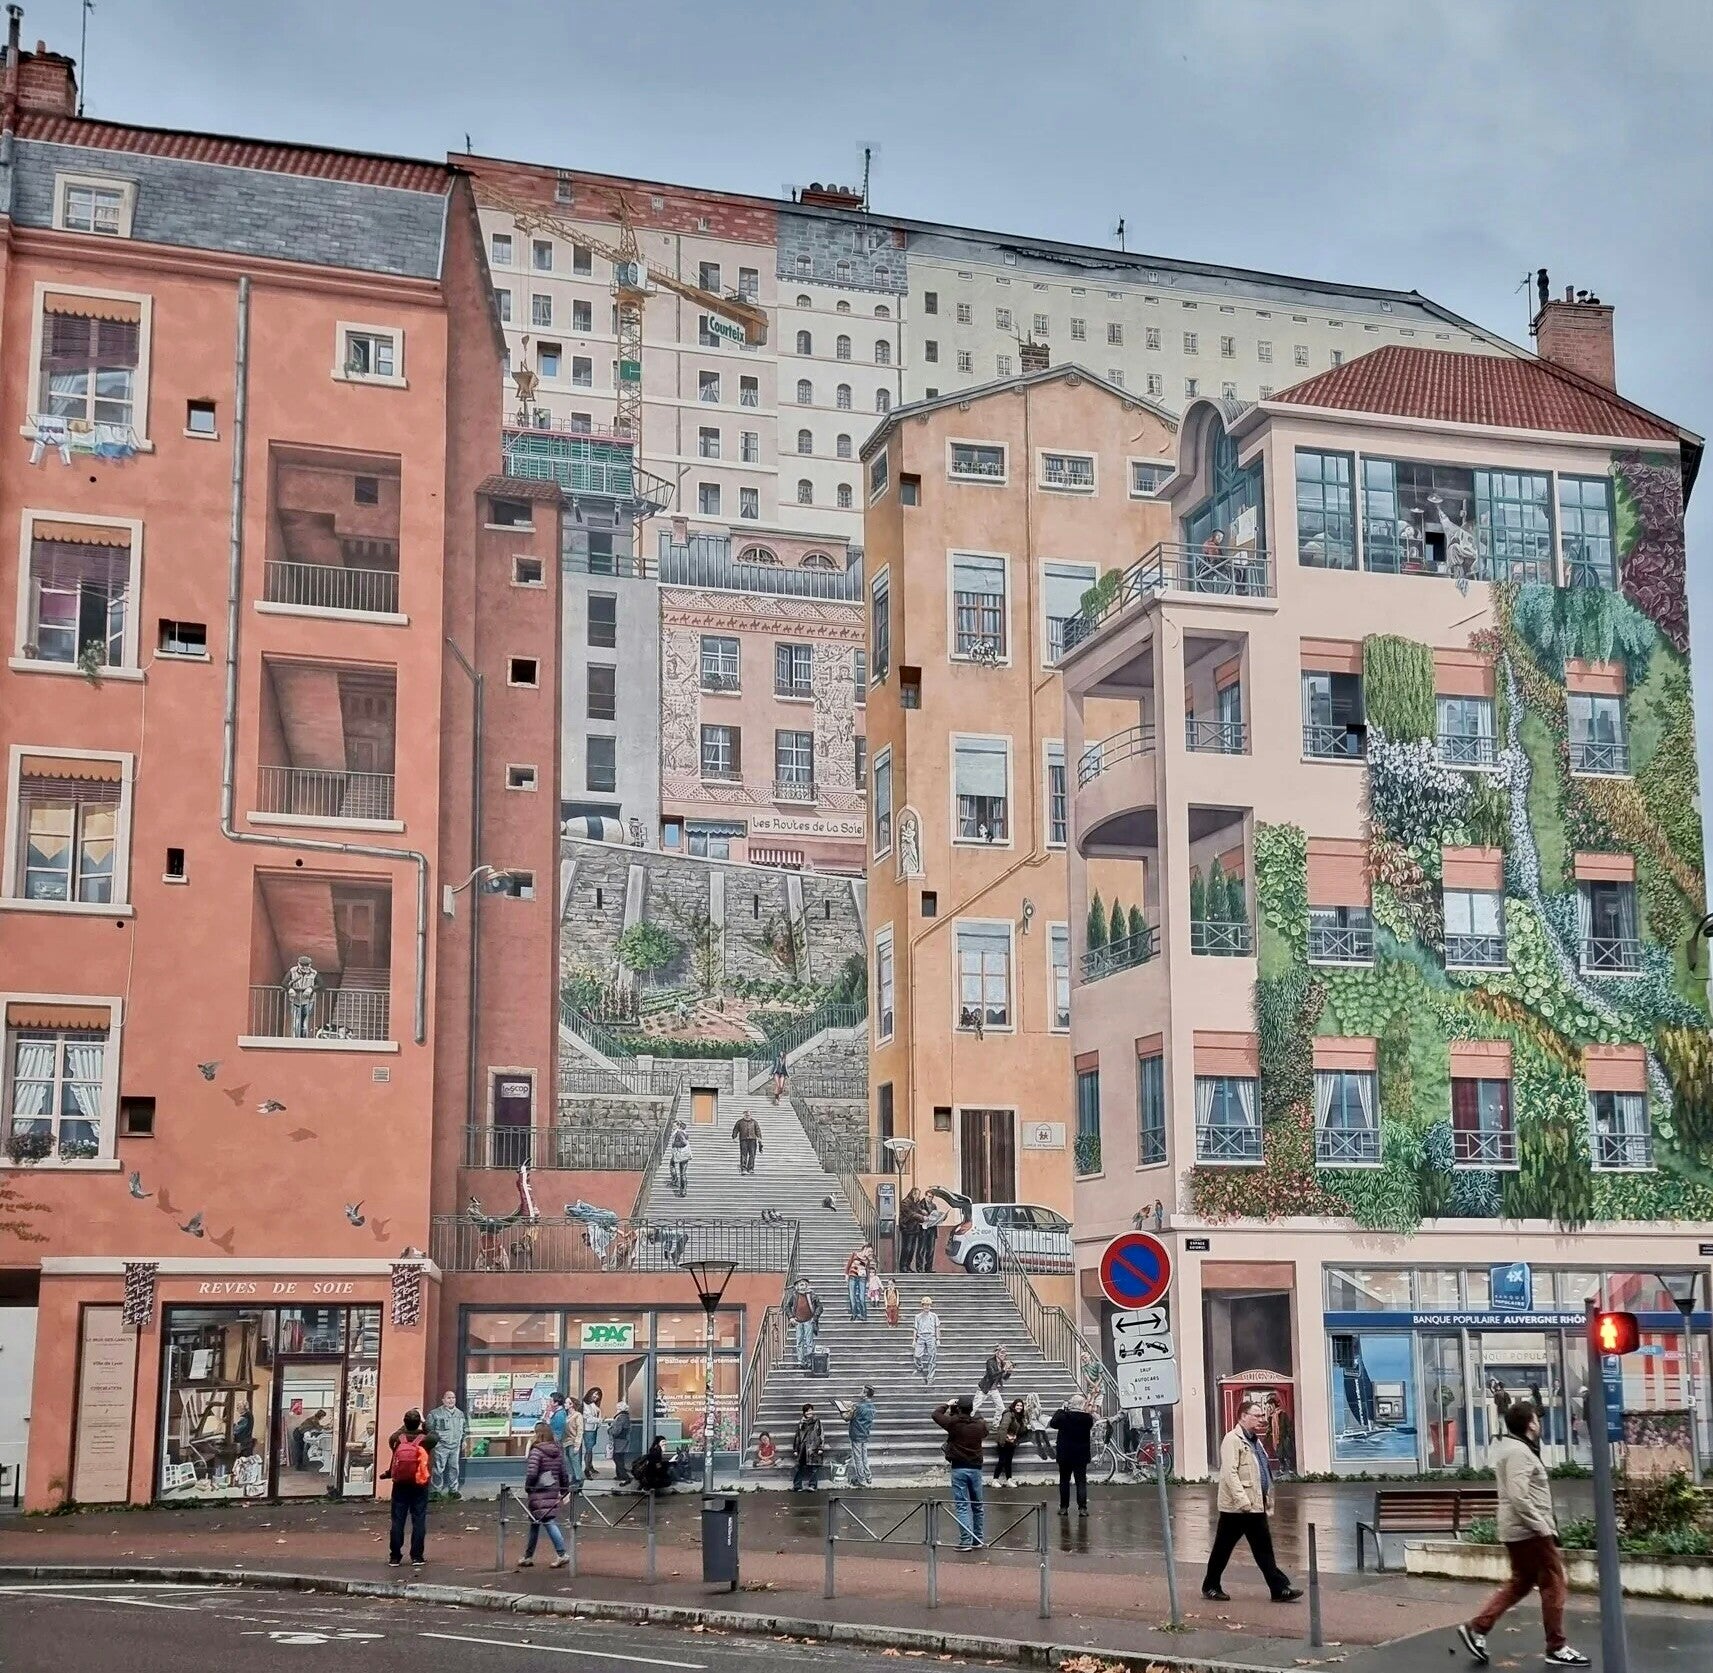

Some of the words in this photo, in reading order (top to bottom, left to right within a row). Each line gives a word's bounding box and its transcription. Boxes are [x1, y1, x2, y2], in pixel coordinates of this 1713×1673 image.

[709, 316, 745, 343] Courteix
[773, 818, 810, 831] Routes
[813, 821, 825, 832] de
[841, 822, 863, 834] Soie
[199, 1282, 257, 1294] REVES
[272, 1282, 297, 1294] DE
[312, 1282, 354, 1294] SOIE
[1413, 1315, 1451, 1325] BANQUE
[1453, 1315, 1500, 1324] POPULAIRE
[1503, 1315, 1558, 1324] AUVERGNE
[1560, 1313, 1587, 1324] RHÔN
[1134, 1375, 1160, 1383] AUTOCARS
